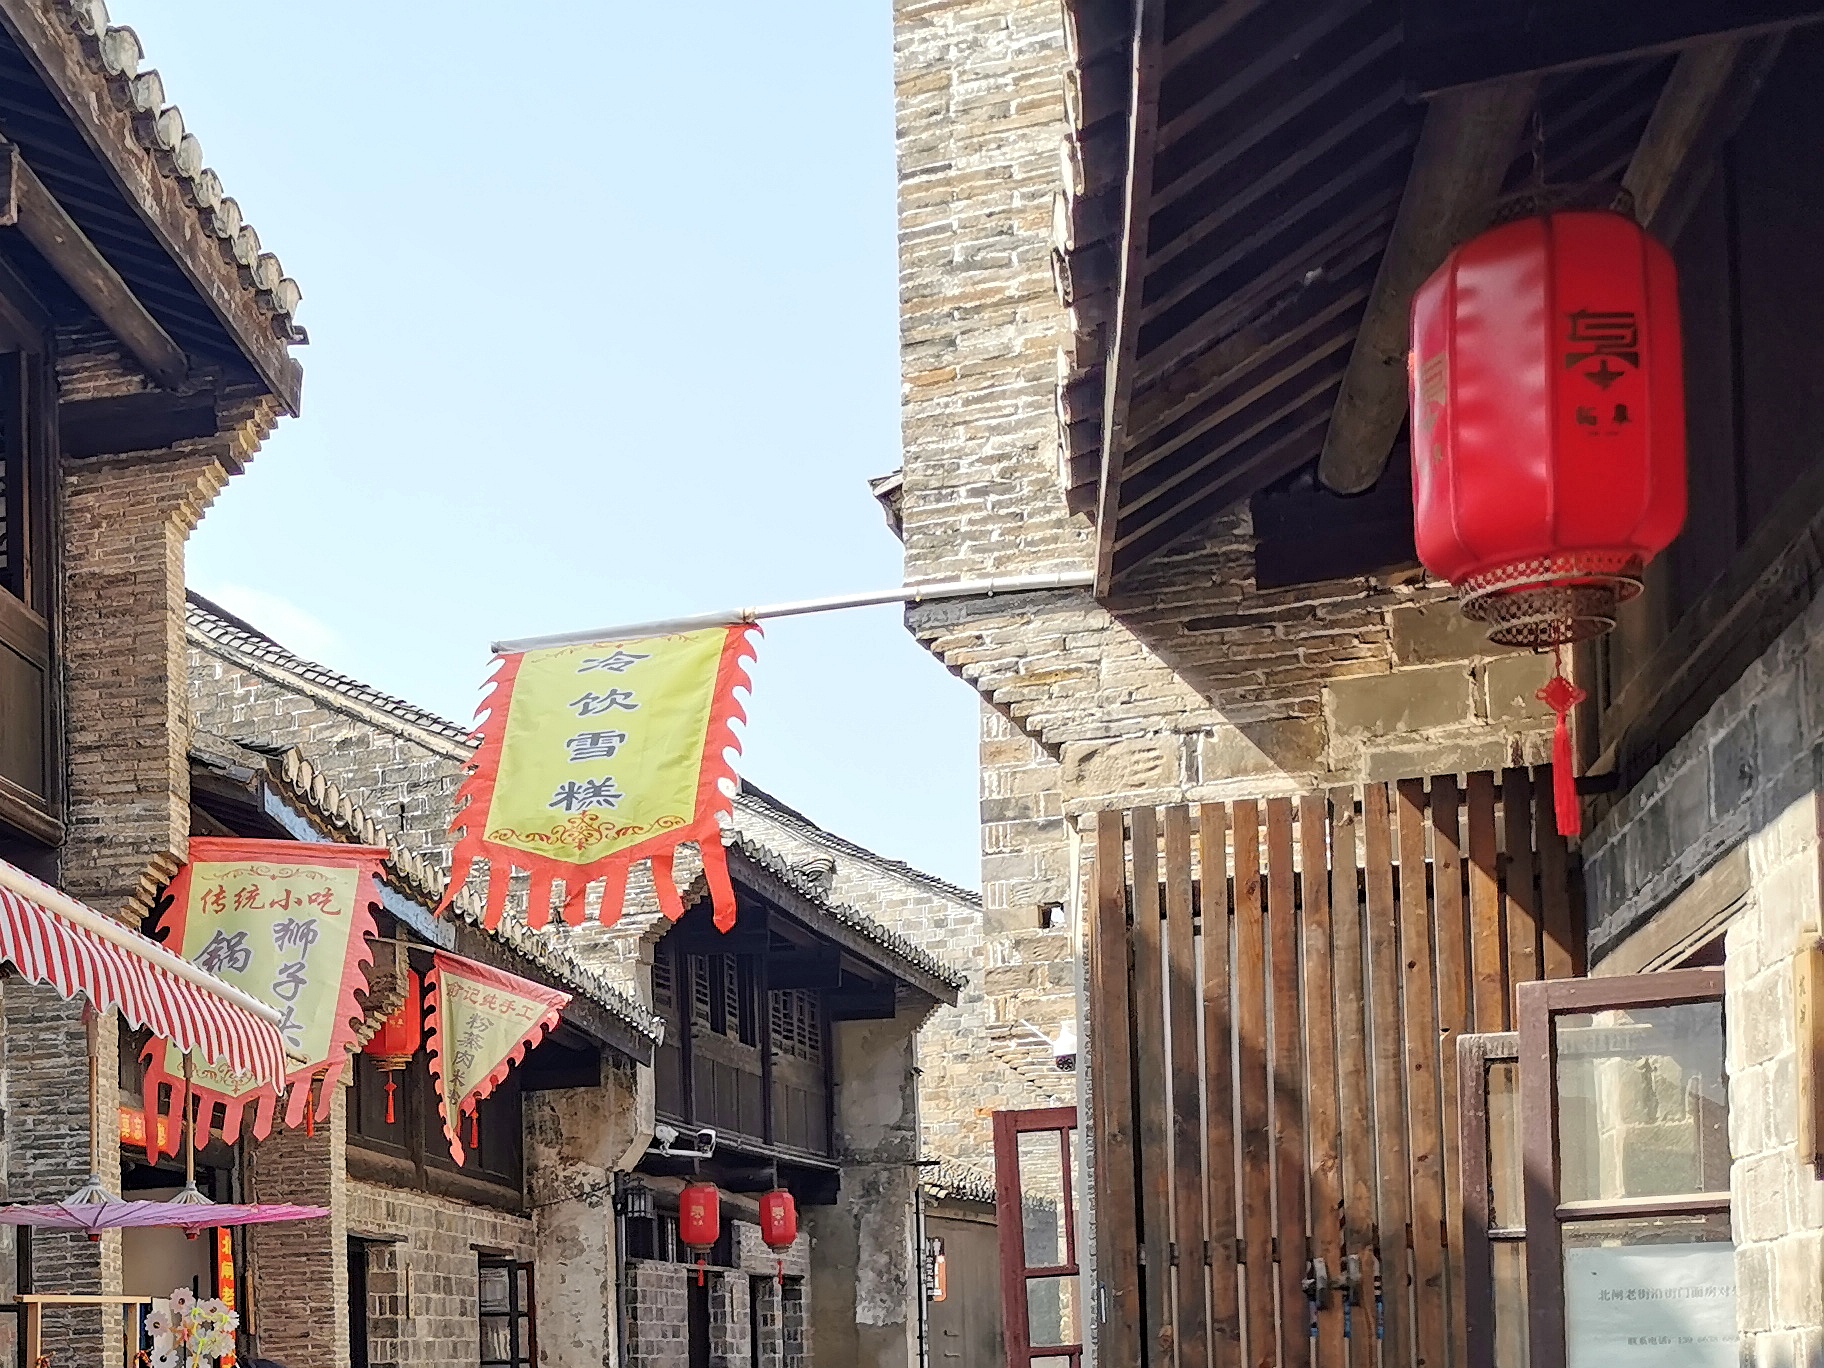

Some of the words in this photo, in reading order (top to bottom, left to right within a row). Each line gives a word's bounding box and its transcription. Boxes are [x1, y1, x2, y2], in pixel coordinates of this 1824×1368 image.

[548, 650, 651, 811] 冷饮雪糕
[200, 883, 342, 916] 传统小吃
